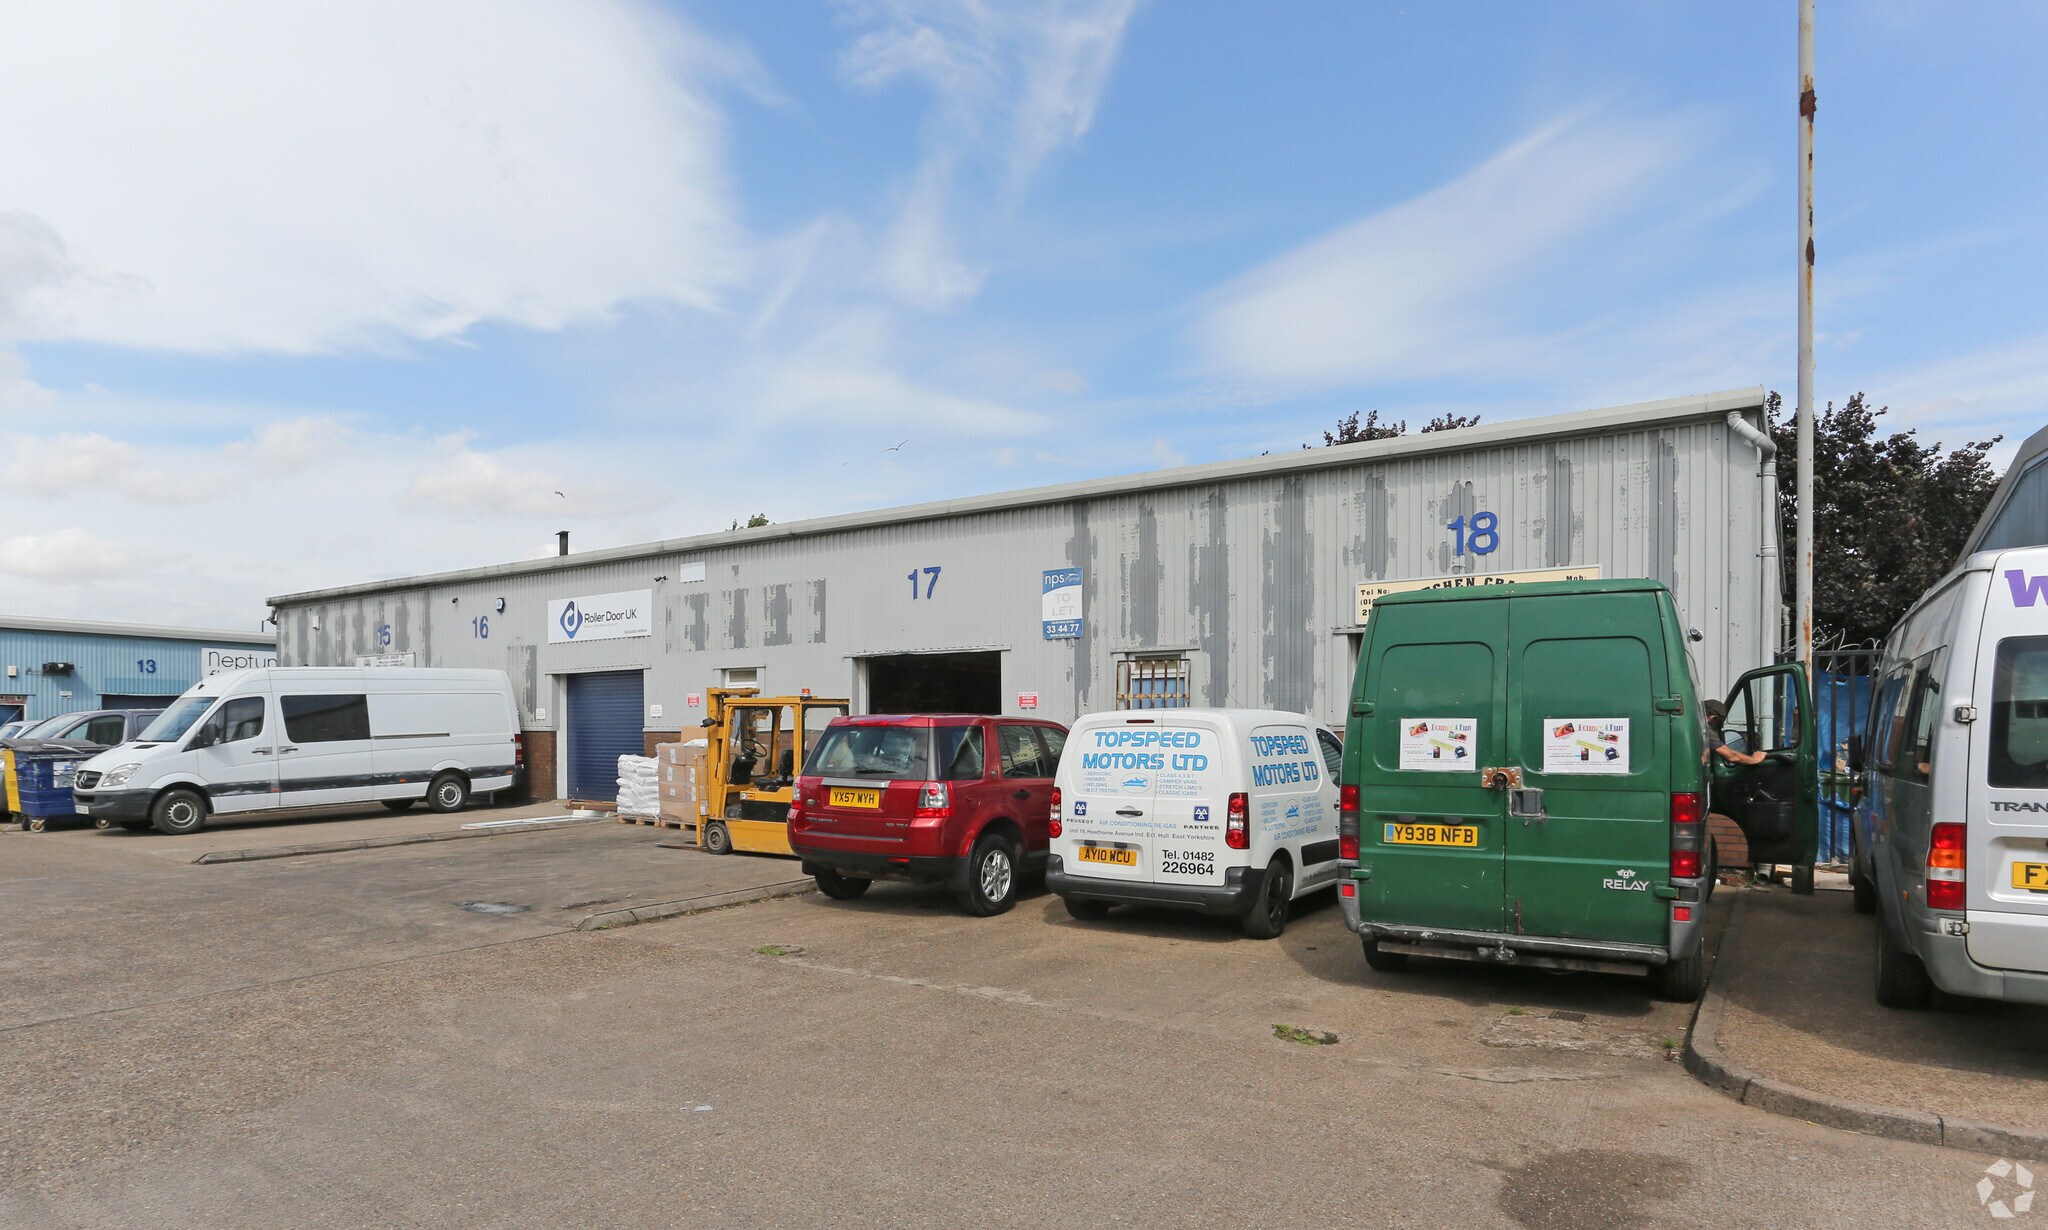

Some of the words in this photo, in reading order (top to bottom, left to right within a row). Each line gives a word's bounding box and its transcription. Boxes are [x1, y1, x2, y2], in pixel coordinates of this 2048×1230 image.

[1447, 511, 1498, 556] 18
[908, 566, 941, 600] 17
[1045, 574, 1065, 588] nps
[1054, 592, 1071, 603] TO
[584, 612, 605, 623] Roller
[605, 610, 625, 621] Door
[625, 608, 637, 619] UK
[1052, 605, 1075, 616] LET
[472, 615, 488, 639] 16
[1046, 624, 1056, 634] 33
[1058, 624, 1068, 633] 44
[1070, 623, 1080, 632] 77
[137, 659, 156, 673] 13
[1094, 731, 1200, 748] TOPSPEED
[1250, 735, 1309, 757] TOPSPEED
[1082, 753, 1165, 770] MOTORS
[1171, 754, 1208, 771] LTD
[1252, 762, 1301, 787] MOTORS
[1301, 761, 1319, 781] LTD
[833, 791, 856, 803] YX57
[857, 793, 875, 804] WYH
[1990, 801, 2048, 813] TRAN
[1110, 820, 1154, 828] CONDITIONING
[1394, 826, 1436, 842] Y938
[1441, 828, 1474, 843] NFB
[1084, 847, 1107, 861] AY10
[1110, 850, 1131, 863] WCU
[1162, 850, 1180, 860] Tel.
[1183, 851, 1215, 861] 01482
[1162, 861, 1215, 876] 226964
[2025, 865, 2048, 886] F
[1603, 878, 1650, 891] RELAY
